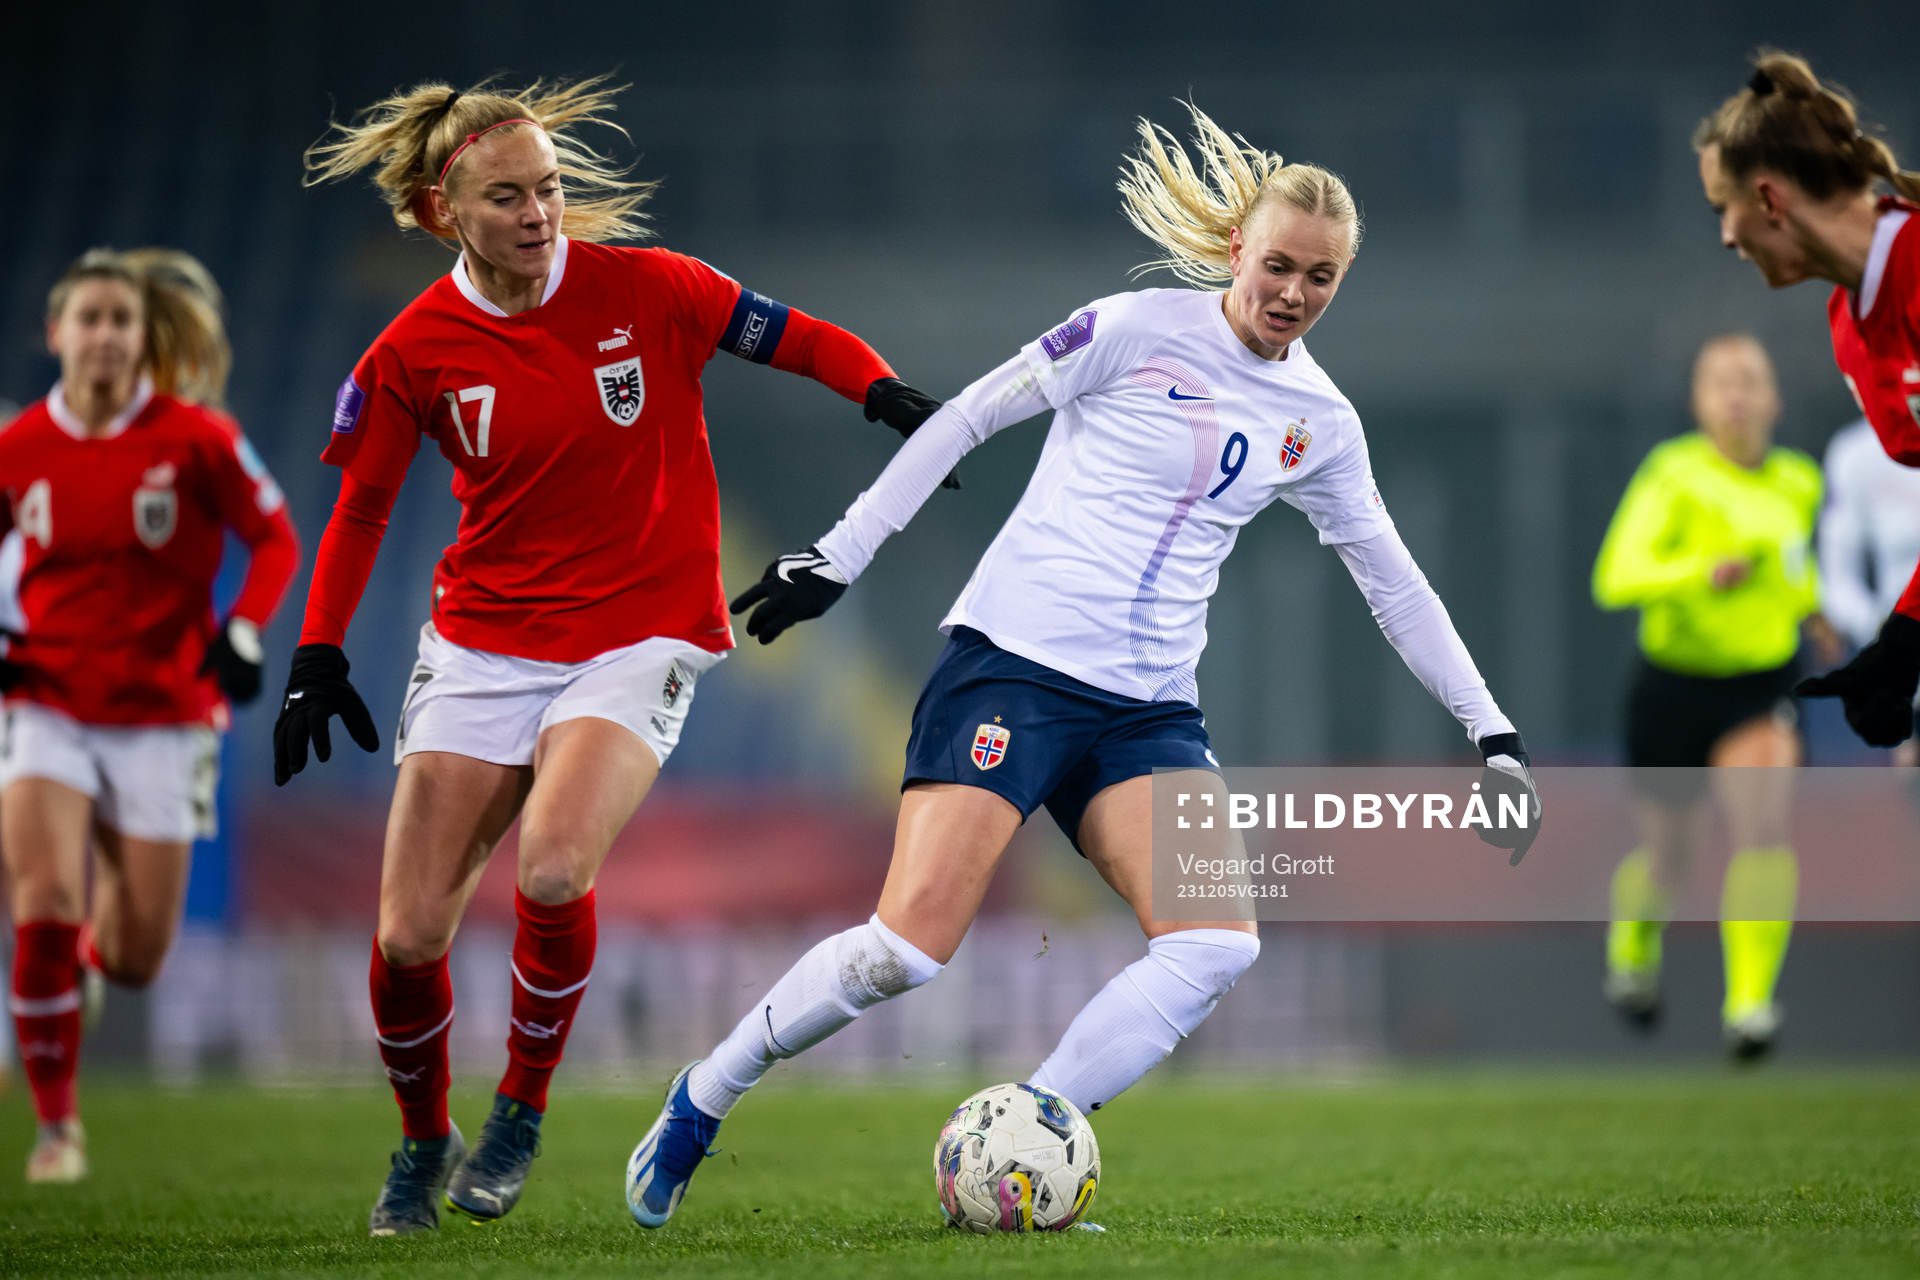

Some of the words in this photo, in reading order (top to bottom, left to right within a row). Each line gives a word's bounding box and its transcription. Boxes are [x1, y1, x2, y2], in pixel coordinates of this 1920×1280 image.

[736, 313, 764, 358] ESPECT
[443, 385, 496, 457] 17
[1207, 432, 1249, 500] 9
